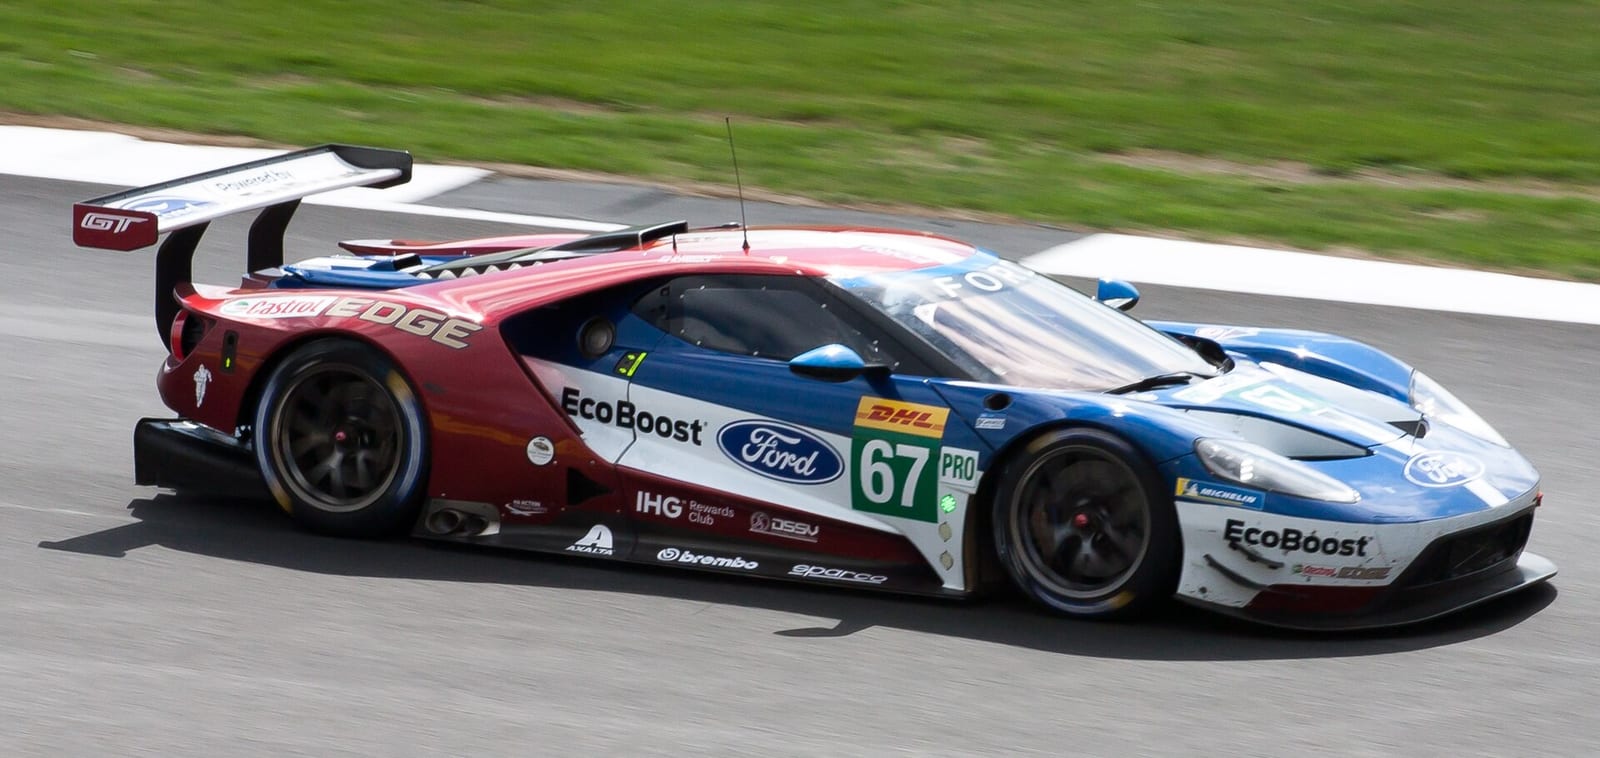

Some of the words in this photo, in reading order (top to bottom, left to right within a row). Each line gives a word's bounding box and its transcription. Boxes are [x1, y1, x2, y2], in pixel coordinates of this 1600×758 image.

[81, 212, 149, 234] GT
[247, 297, 317, 315] Castrol
[325, 298, 483, 350] EDGE
[561, 387, 703, 446] EcoBoost
[867, 404, 934, 429] DHL
[742, 427, 818, 476] Ford
[860, 439, 931, 508] 67
[941, 453, 975, 481] PRO
[636, 490, 682, 518] IHG
[689, 500, 735, 518] Rewards
[1199, 487, 1256, 504] MICHELIN
[688, 512, 714, 526] Club
[565, 544, 613, 556] AXALTA
[1223, 518, 1368, 557] EcoBoost
[679, 550, 759, 570] brembo
[790, 564, 888, 584] sparco
